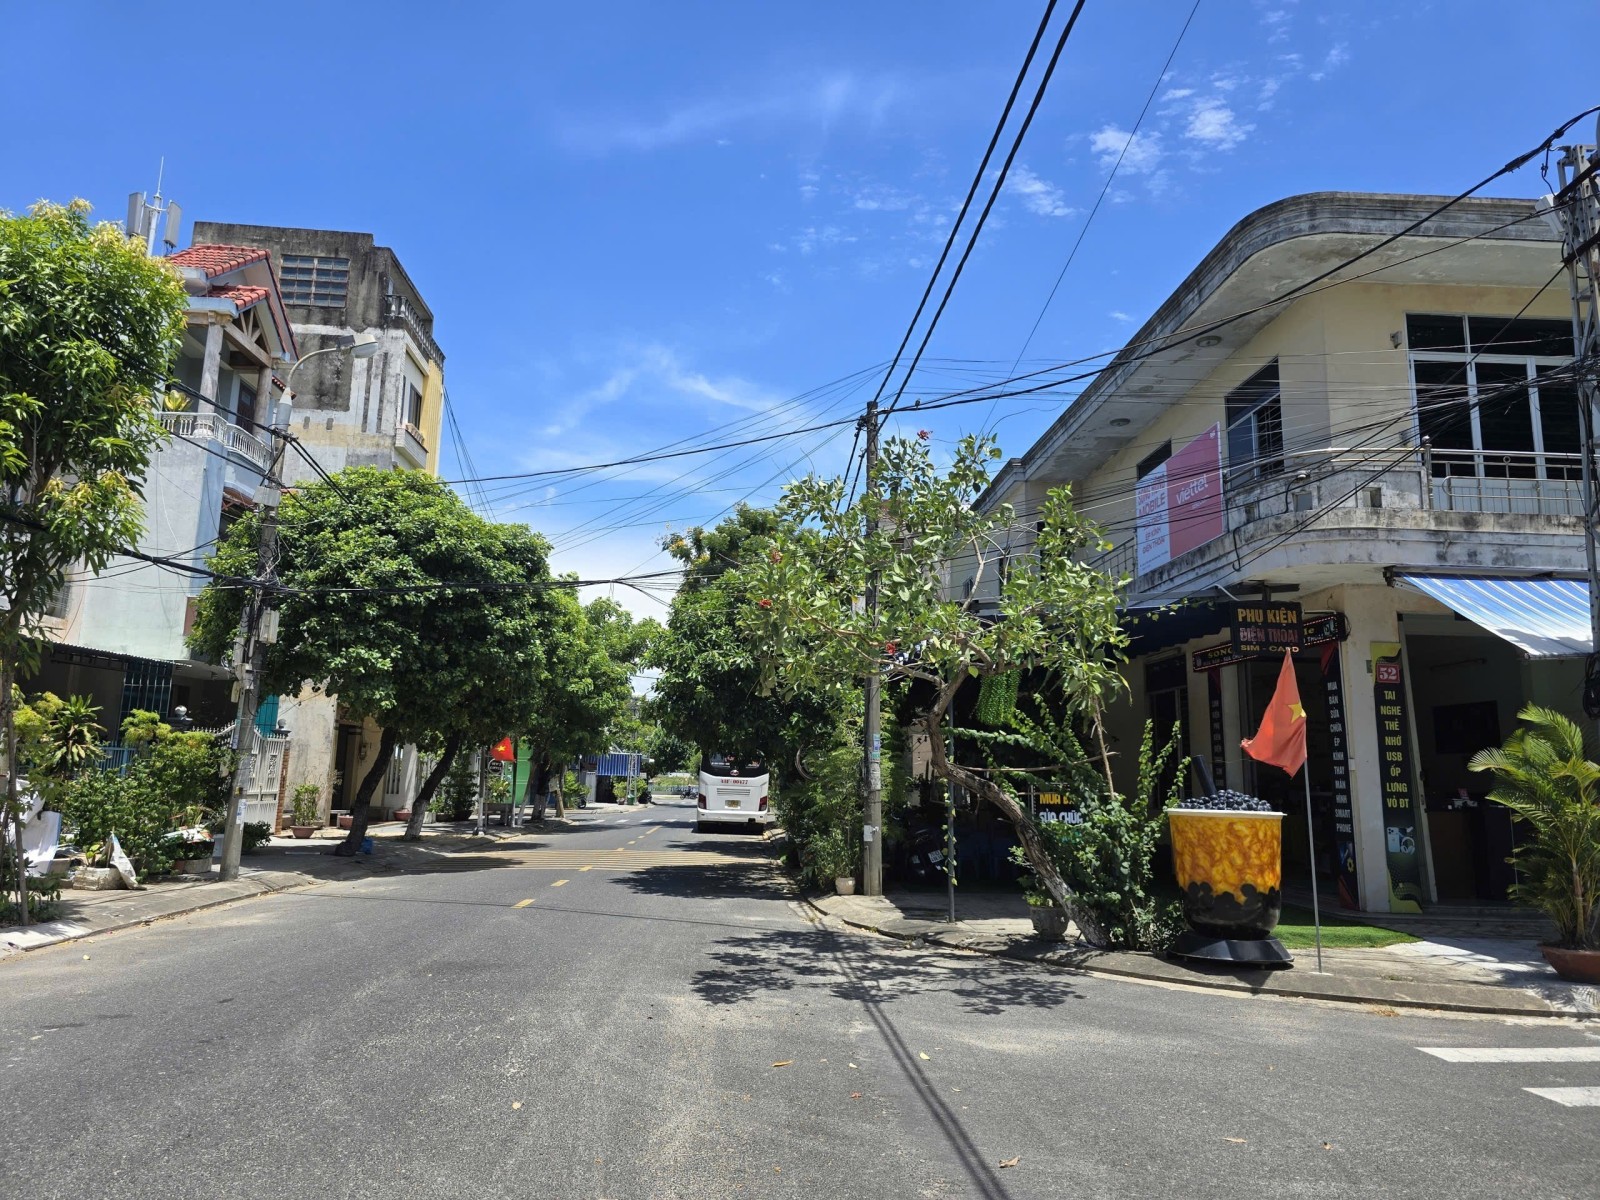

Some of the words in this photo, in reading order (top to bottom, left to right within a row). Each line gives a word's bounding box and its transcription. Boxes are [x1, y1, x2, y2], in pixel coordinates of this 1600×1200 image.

[1237, 608, 1264, 625] PHỤ
[1266, 607, 1297, 626] KIỆN
[1239, 626, 1265, 644] ĐIỆN
[1267, 628, 1298, 645] THOẠI
[1240, 644, 1260, 652] SIM
[1379, 667, 1398, 680] 52
[1384, 691, 1396, 700] TAI
[1380, 706, 1402, 715] NGHE
[1384, 718, 1400, 730] THẺ
[1333, 736, 1341, 747] ÉP
[1386, 752, 1403, 762] USB
[1334, 766, 1345, 775] THAY
[1390, 764, 1401, 777] ỐP
[1386, 783, 1408, 793] LƯNG
[1039, 793, 1061, 805] MUA
[1387, 795, 1397, 808] VỎ
[1399, 799, 1409, 808] ĐT
[1335, 809, 1351, 818] SMART
[1336, 823, 1352, 833] PHONE
